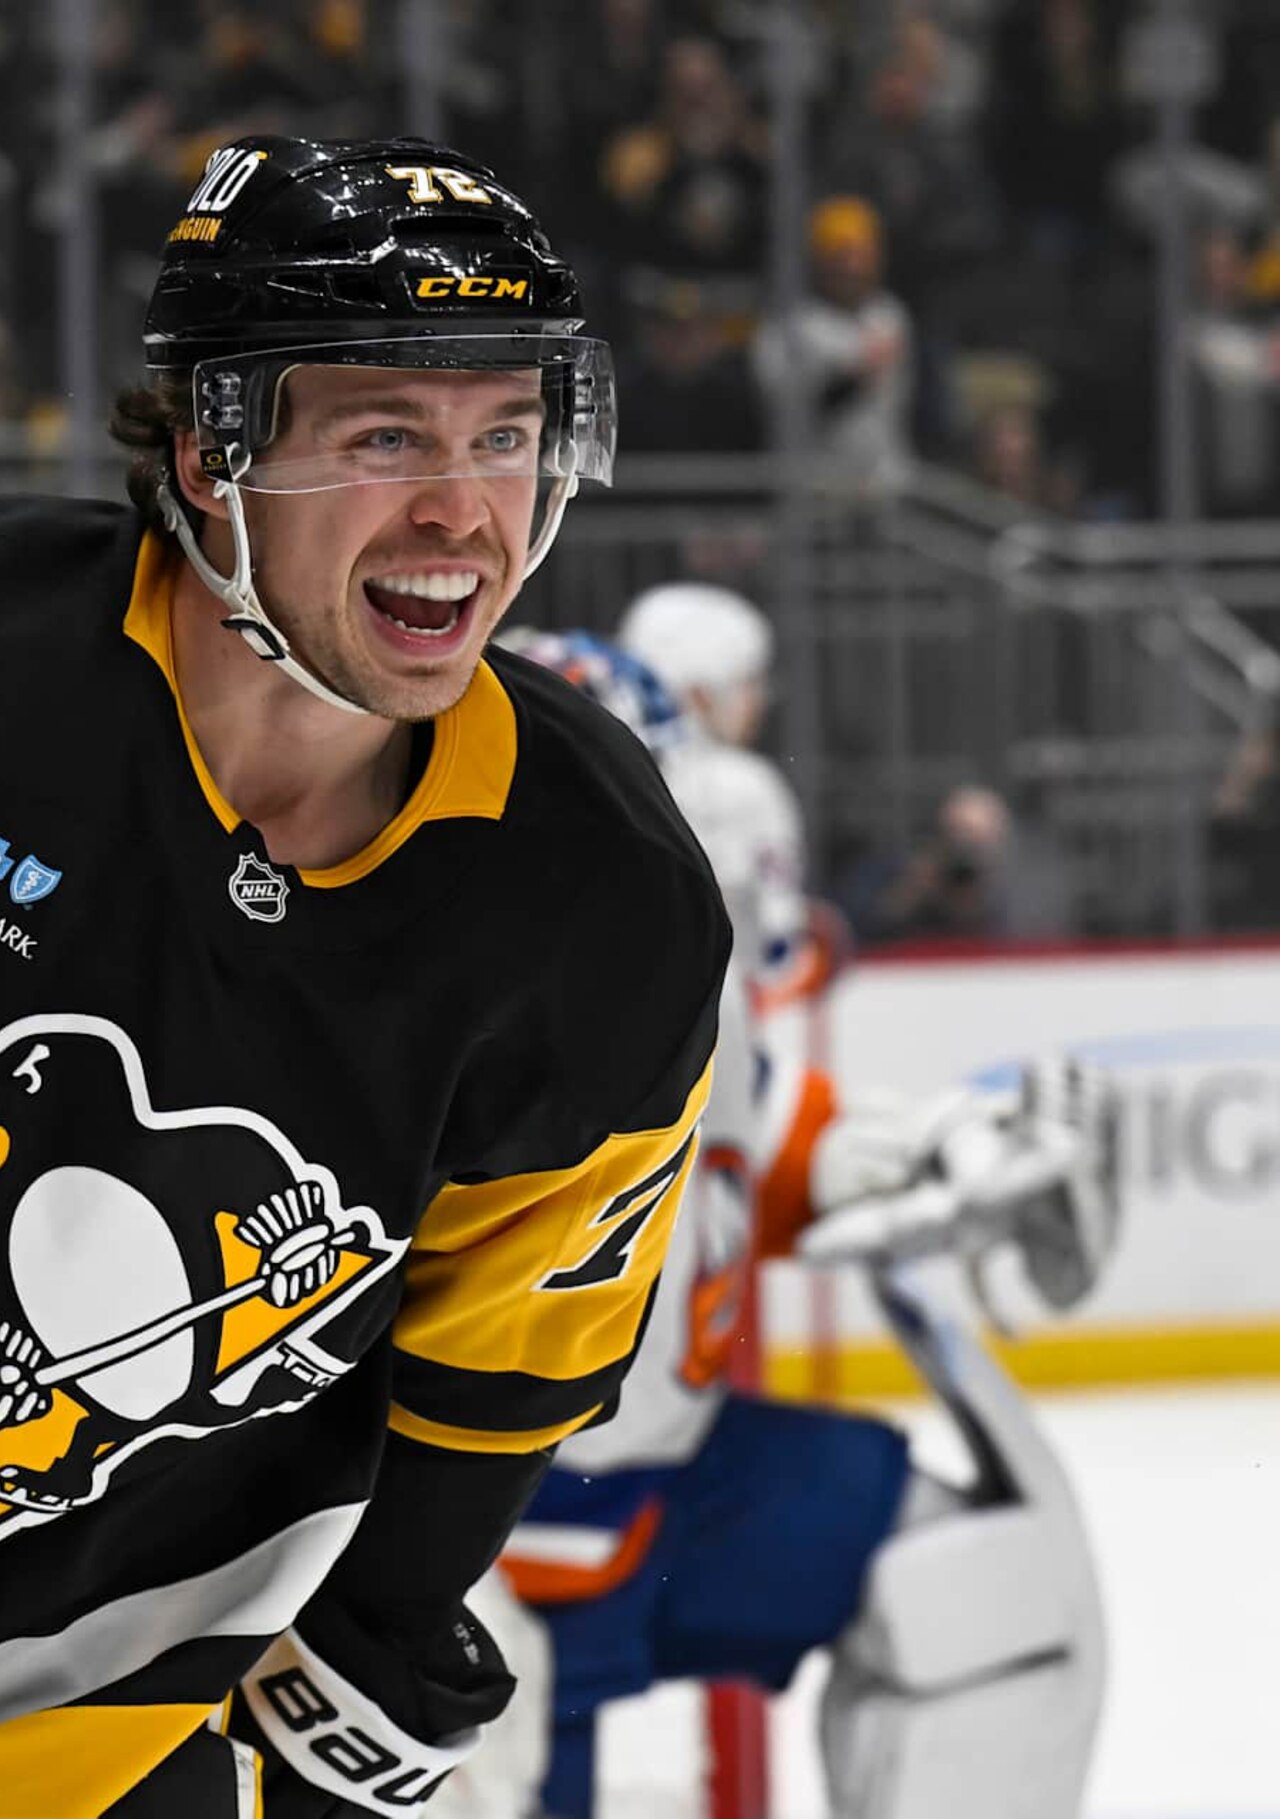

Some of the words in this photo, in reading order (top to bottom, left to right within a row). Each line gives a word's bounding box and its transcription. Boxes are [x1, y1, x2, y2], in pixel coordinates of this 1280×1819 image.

[187, 147, 261, 212] OLD
[385, 167, 492, 204] 72
[416, 277, 528, 299] CCM
[240, 884, 277, 898] NHL
[531, 1123, 700, 1292] 7
